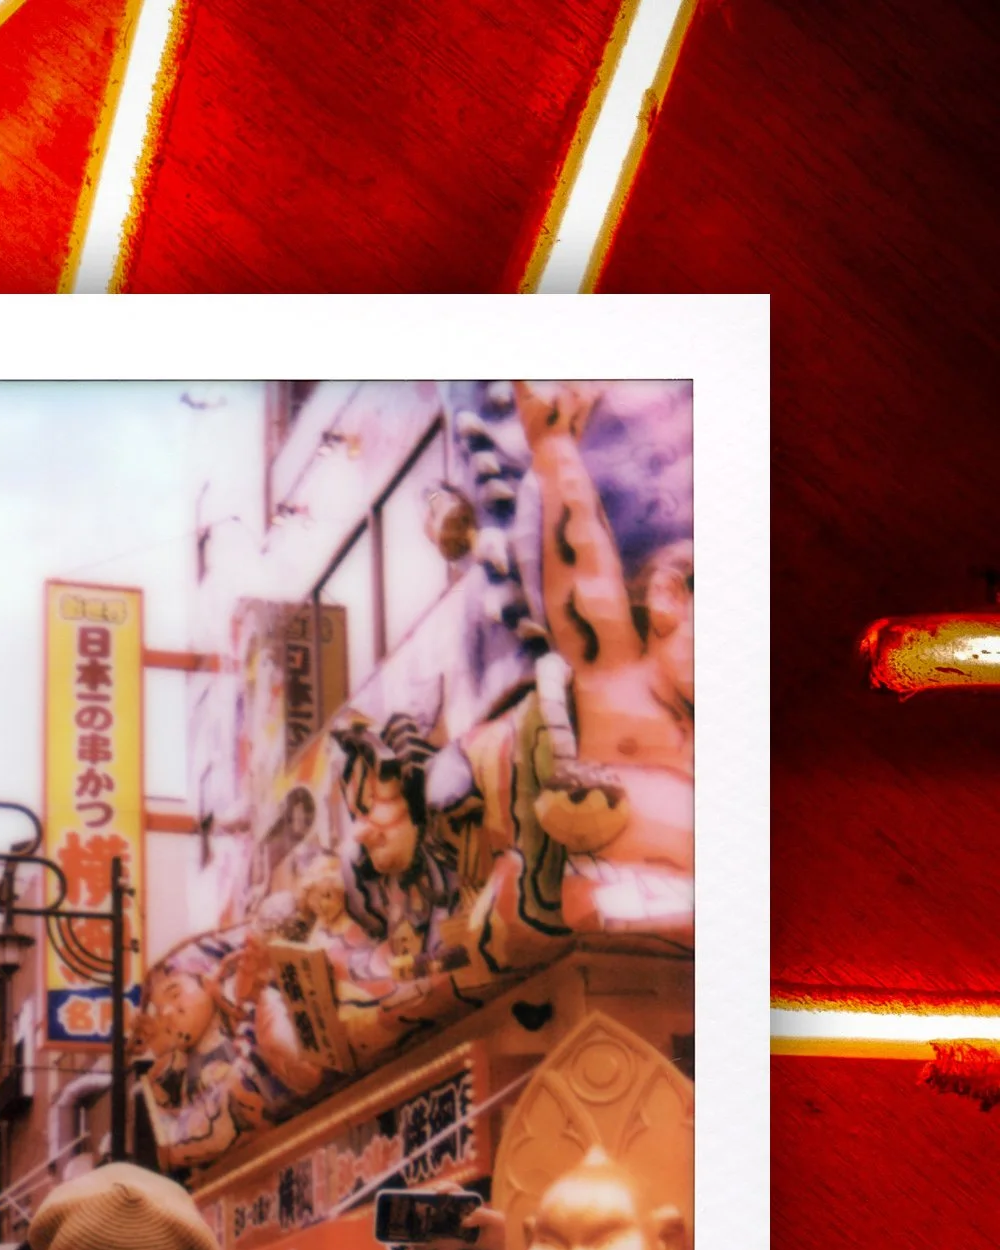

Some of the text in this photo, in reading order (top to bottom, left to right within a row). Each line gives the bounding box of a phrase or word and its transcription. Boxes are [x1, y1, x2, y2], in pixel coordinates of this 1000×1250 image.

[74, 626, 115, 828] 日本一の串かつ
